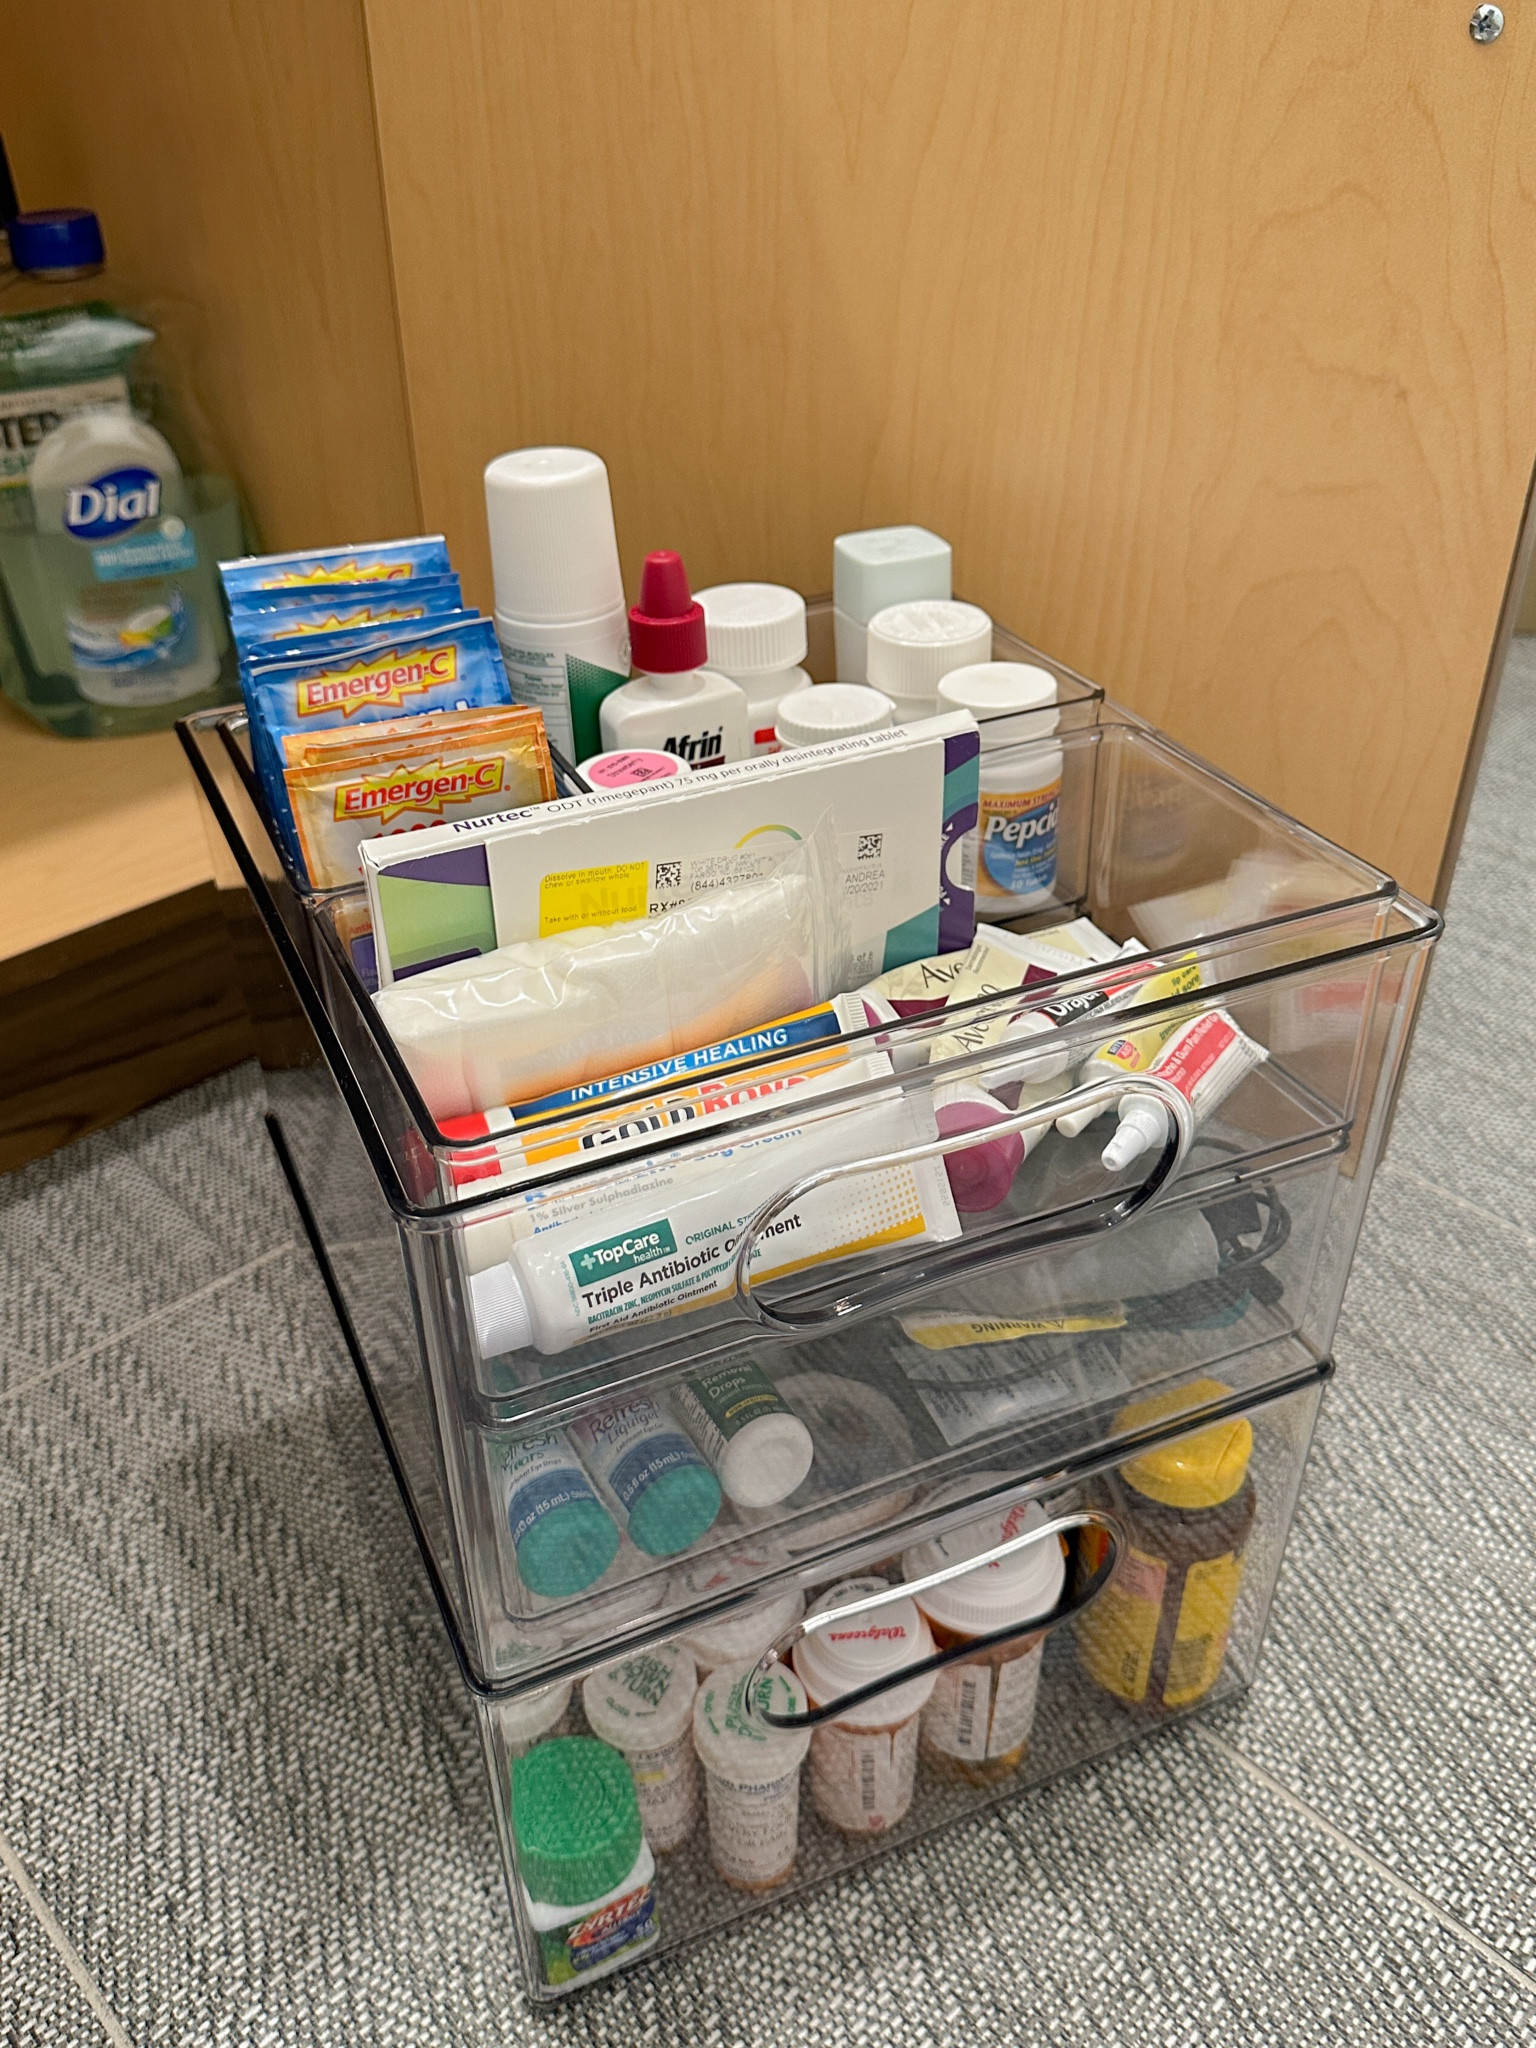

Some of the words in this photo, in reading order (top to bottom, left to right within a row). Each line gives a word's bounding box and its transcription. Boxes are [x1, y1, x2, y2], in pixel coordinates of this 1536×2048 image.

[68, 480, 161, 526] Dial
[306, 651, 450, 707] Emergen-C
[663, 731, 722, 761] Afrin
[547, 799, 583, 814] ODT
[587, 779, 675, 806] (rimegepant)
[679, 775, 693, 787] 75
[696, 770, 717, 783] mg
[720, 766, 741, 779] per
[744, 757, 779, 773] orally
[782, 738, 869, 765] disintegrating
[873, 729, 908, 746] tablet
[344, 763, 496, 813] Emergen-C
[983, 799, 1031, 809] MAXIMUM
[544, 872, 576, 883] Dissolve
[616, 864, 628, 873] DO
[630, 861, 645, 872] NOT
[544, 879, 564, 889] chew
[576, 876, 606, 885] swallow
[845, 870, 885, 884] ANDREA
[544, 915, 561, 924] Take
[564, 912, 579, 921] with
[592, 907, 619, 918] without
[621, 905, 638, 914] food
[571, 1056, 687, 1101] INTENSIVE
[693, 1028, 788, 1067] HEALING
[529, 1210, 549, 1224] 1%
[551, 1200, 587, 1218] Silver
[589, 1176, 674, 1208] Sulphadiazine
[685, 1221, 736, 1245] ORIGINAL
[593, 1232, 660, 1263] TopCare
[582, 1277, 635, 1310] Triple
[639, 1244, 721, 1289] Antibiotic
[587, 1303, 624, 1325] BACITRACIN
[624, 1297, 642, 1311] ZINC,
[640, 1286, 672, 1304] NEOMYCIN
[672, 1274, 695, 1293] SULFATE
[589, 1320, 610, 1333] First
[612, 1314, 629, 1326] Aid
[631, 1297, 677, 1319] Antibiotic
[677, 1279, 718, 1301] Ointment
[971, 1319, 1046, 1334] WARNING
[701, 1363, 752, 1388] Removal
[708, 1376, 746, 1399] Drops
[638, 1469, 650, 1482] oz
[551, 1491, 570, 1507] mL)
[828, 1625, 908, 1642] Walgreens
[755, 1675, 774, 1710] URN
